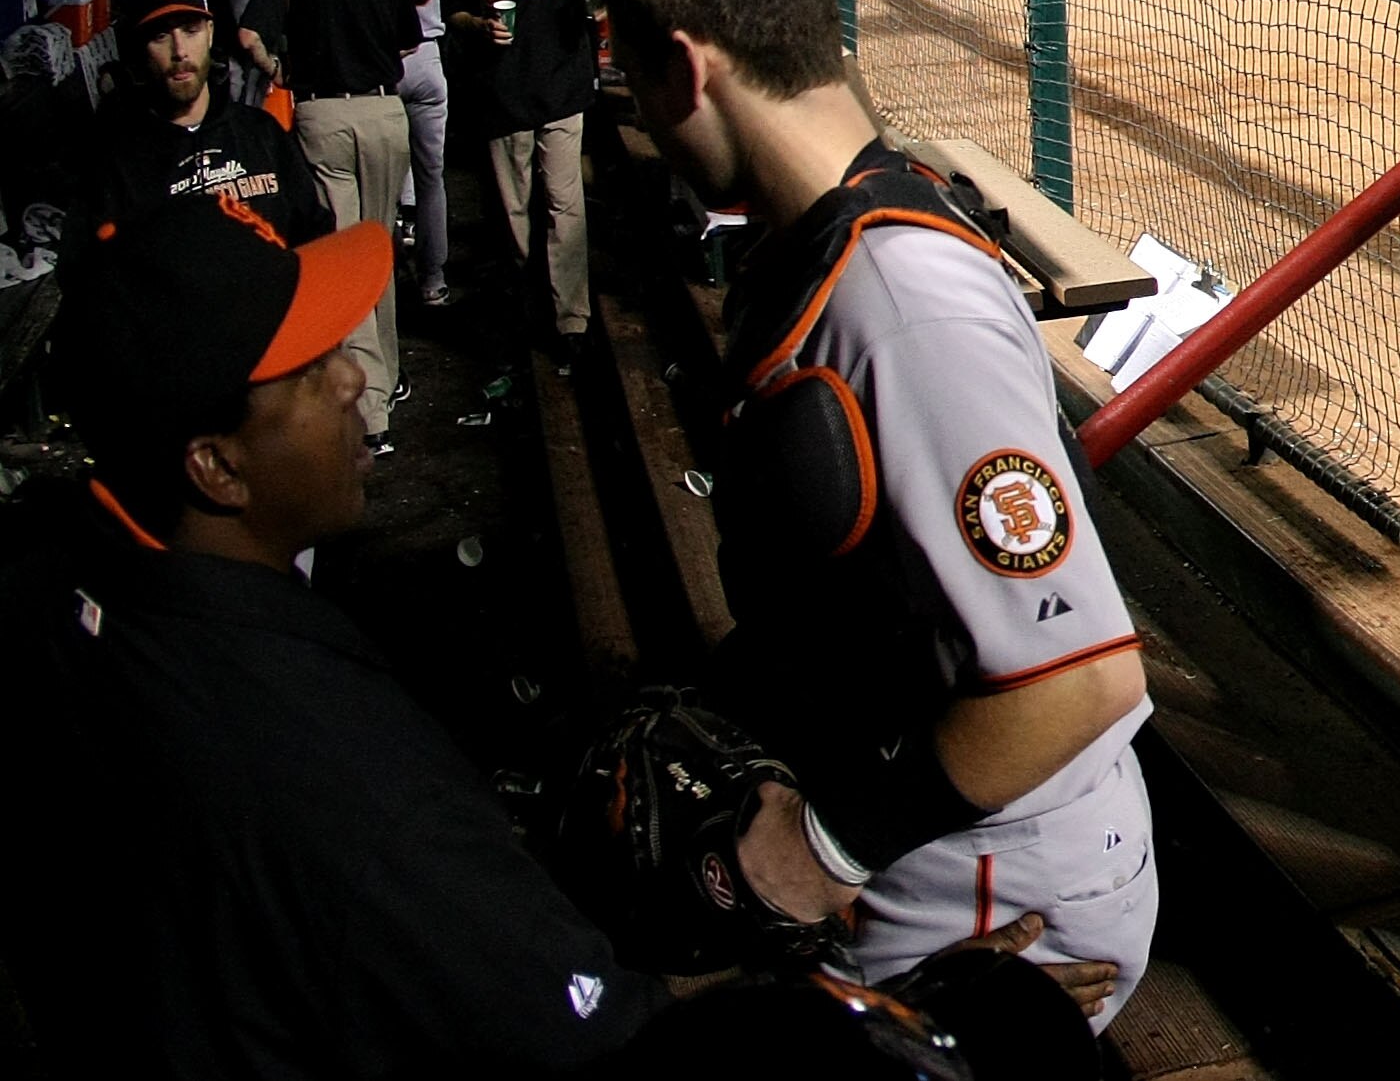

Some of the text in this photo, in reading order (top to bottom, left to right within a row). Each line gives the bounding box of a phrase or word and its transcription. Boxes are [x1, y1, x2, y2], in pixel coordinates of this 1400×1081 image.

[237, 172, 279, 199] GIANTS
[974, 455, 1065, 515] FRANCISCO
[965, 494, 985, 539] SAN
[997, 531, 1066, 569] GIANTS
